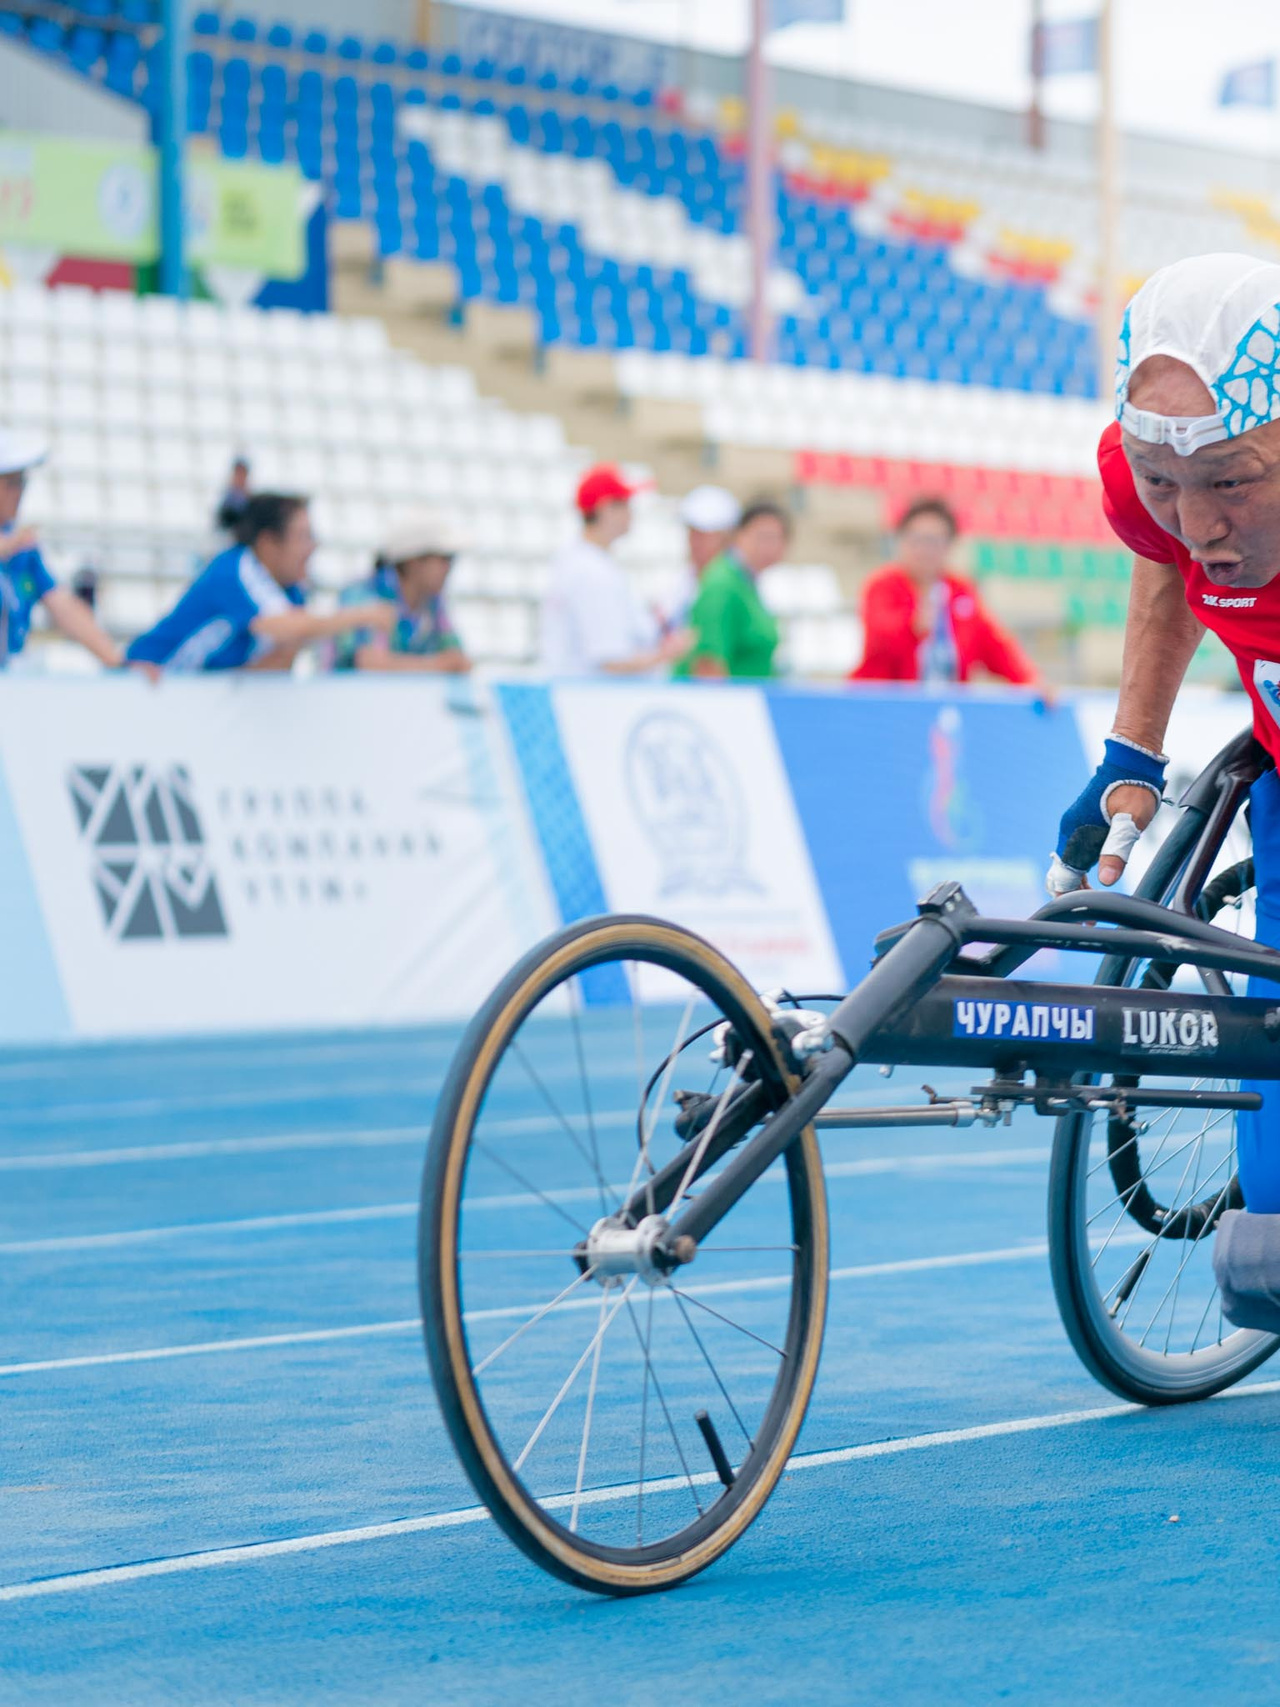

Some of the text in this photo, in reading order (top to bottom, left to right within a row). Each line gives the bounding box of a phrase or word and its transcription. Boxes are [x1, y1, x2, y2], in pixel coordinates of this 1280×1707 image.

[1218, 598, 1257, 608] SPORT
[956, 1001, 1094, 1040] ЧУРАПЧЫ
[1123, 1009, 1219, 1047] LUKOR
